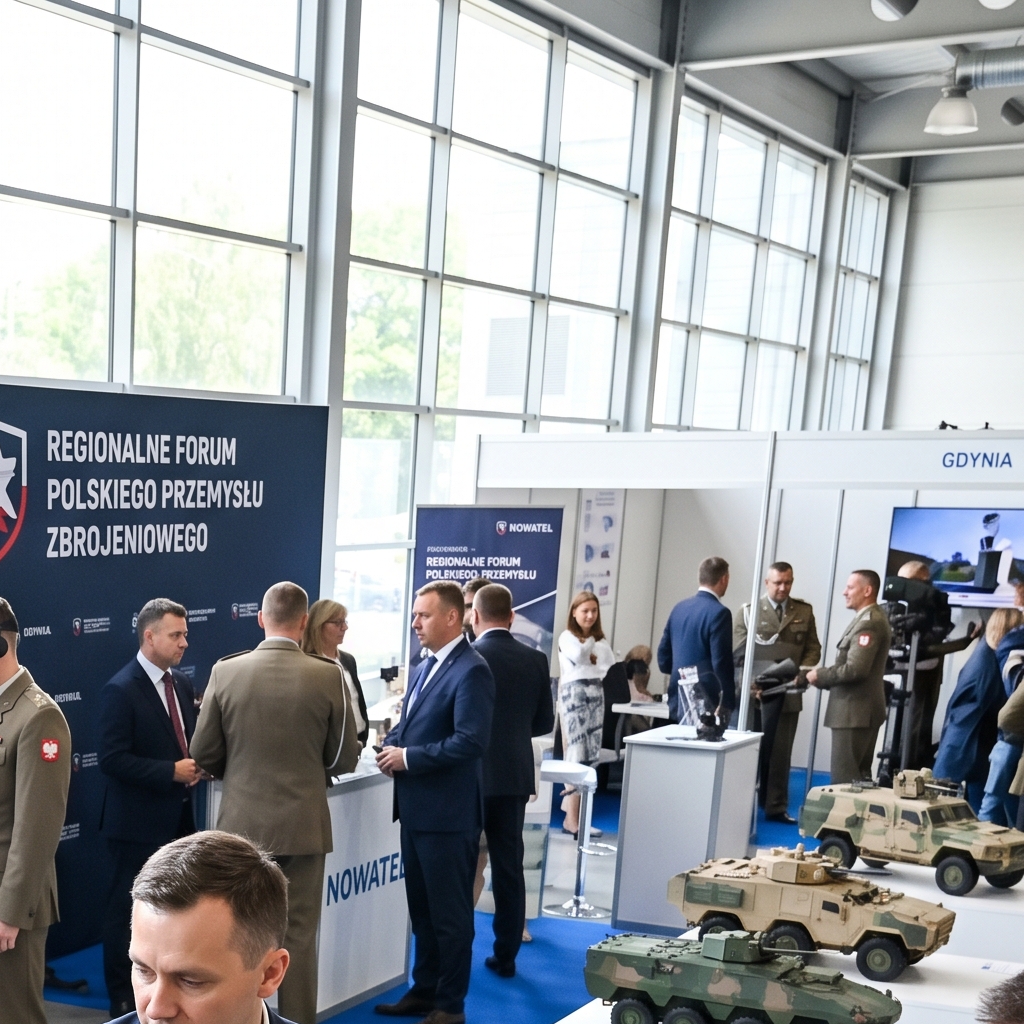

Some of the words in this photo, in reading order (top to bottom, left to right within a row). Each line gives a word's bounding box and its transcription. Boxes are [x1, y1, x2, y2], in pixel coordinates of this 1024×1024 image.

[47, 429, 171, 464] REGIONALNE
[175, 435, 237, 466] FORUM
[942, 452, 1013, 468] GDYNIA
[47, 478, 157, 511] POLSKIEGO
[161, 479, 264, 509] PRZEMYSŁU
[46, 522, 208, 558] ZBROJENIOWEGO
[509, 523, 553, 533] NOWATEL
[487, 556, 521, 567] FORUM
